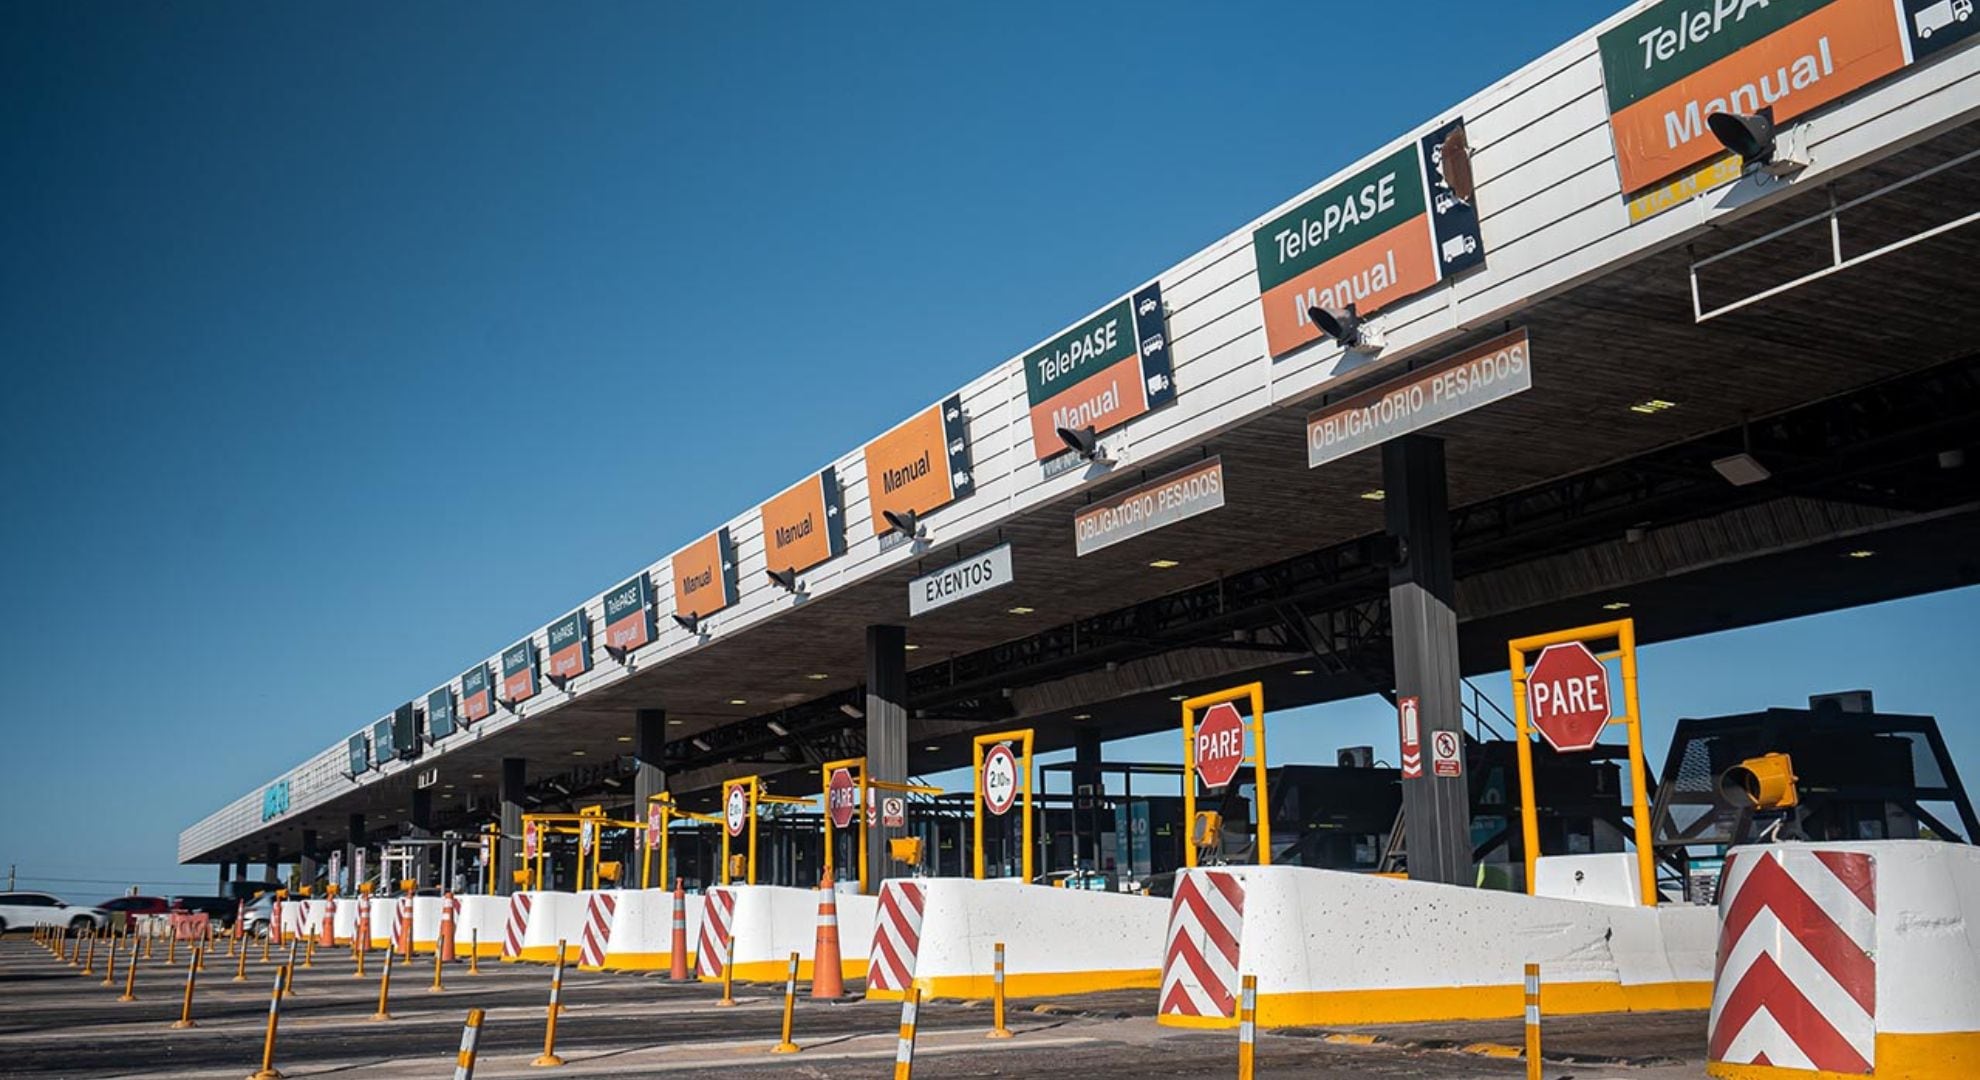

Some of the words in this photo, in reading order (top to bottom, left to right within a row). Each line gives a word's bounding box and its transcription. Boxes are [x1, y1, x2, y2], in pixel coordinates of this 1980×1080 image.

[1274, 172, 1396, 264] TelePASE
[1295, 250, 1398, 327] Manual
[1038, 319, 1118, 385] TelePASE
[1053, 380, 1119, 438] Manual
[1312, 385, 1424, 450] OBLIGATORIO
[1432, 346, 1524, 405] PESADOS
[883, 450, 931, 494] Manual
[1079, 495, 1152, 542] OBLIGATORIO
[1158, 470, 1219, 512] PESADOS
[775, 513, 813, 549] Manual
[683, 566, 713, 596] Manual
[926, 559, 993, 602] EXENTOS
[1533, 675, 1604, 718] PARE
[1200, 727, 1240, 762] PARE
[830, 786, 853, 809] PARE
